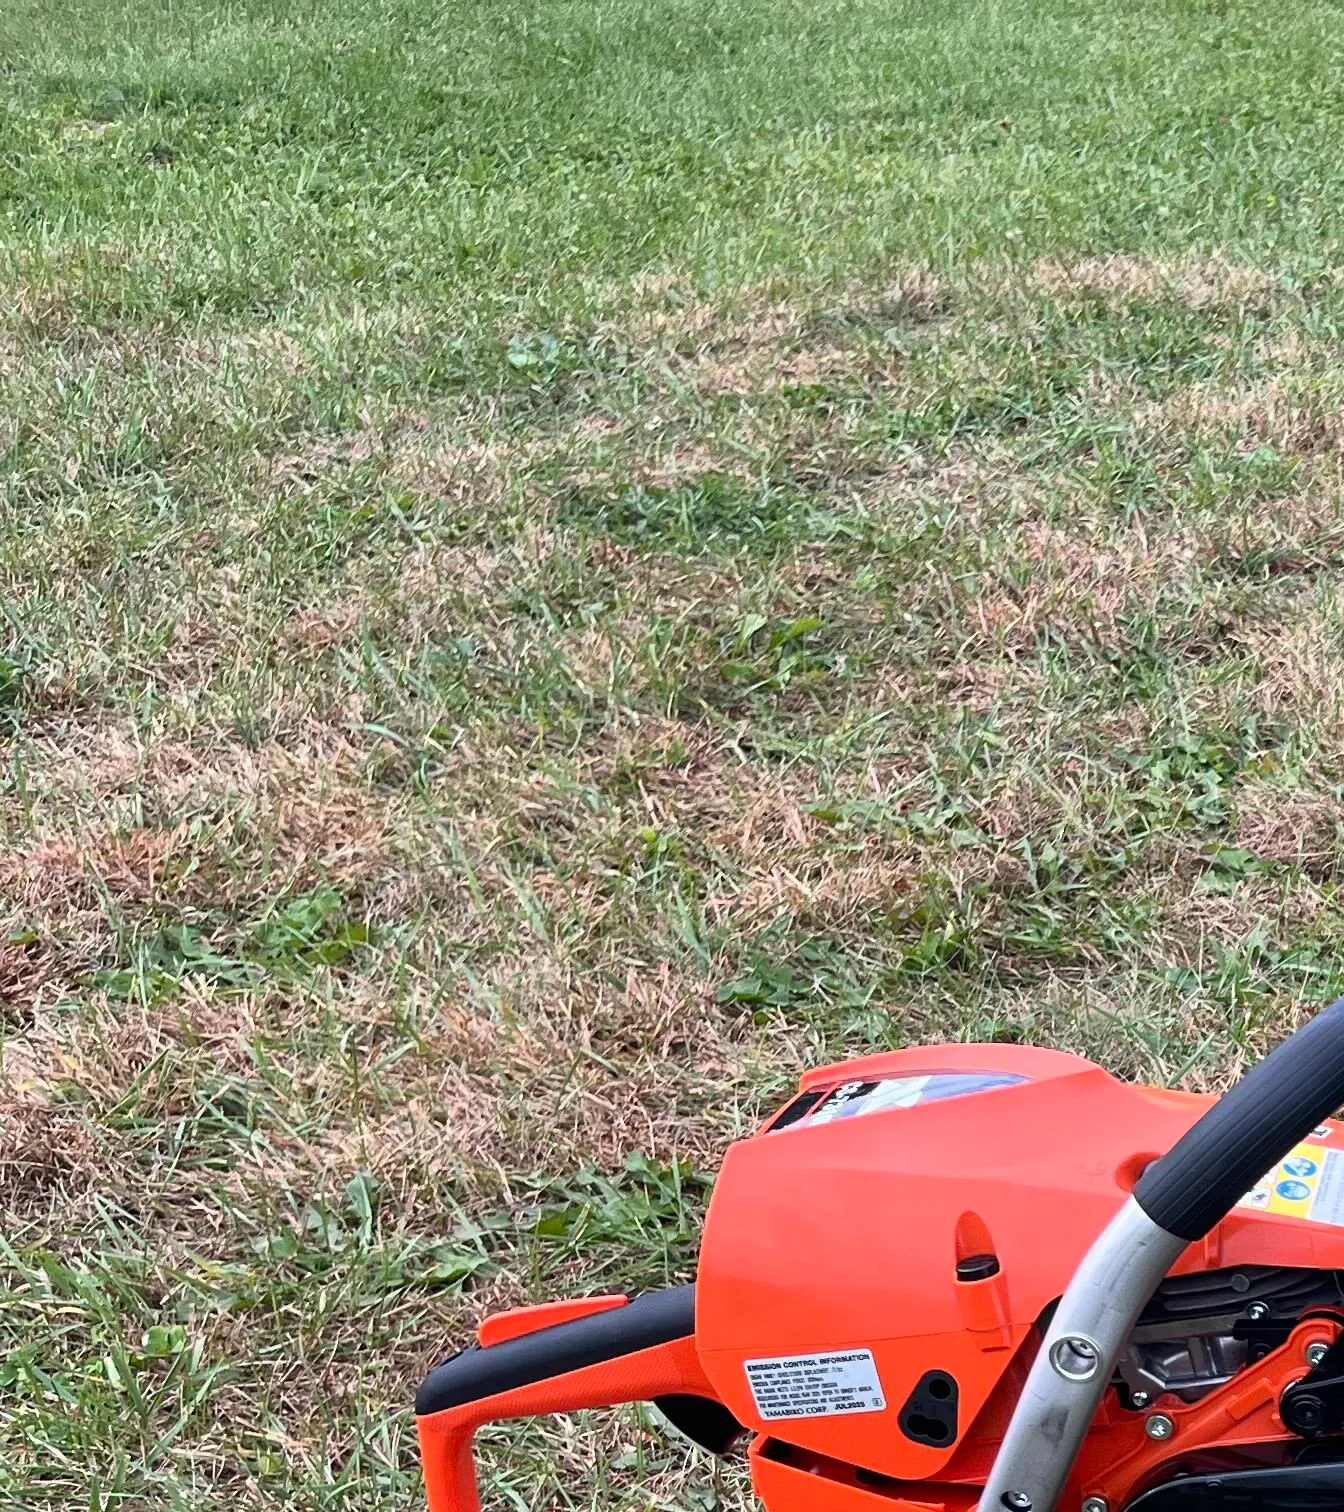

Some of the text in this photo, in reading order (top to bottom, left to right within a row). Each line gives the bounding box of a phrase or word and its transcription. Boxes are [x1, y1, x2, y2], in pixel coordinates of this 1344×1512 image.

[747, 1354, 870, 1371] EMISSION CONTROL INFORMATION
